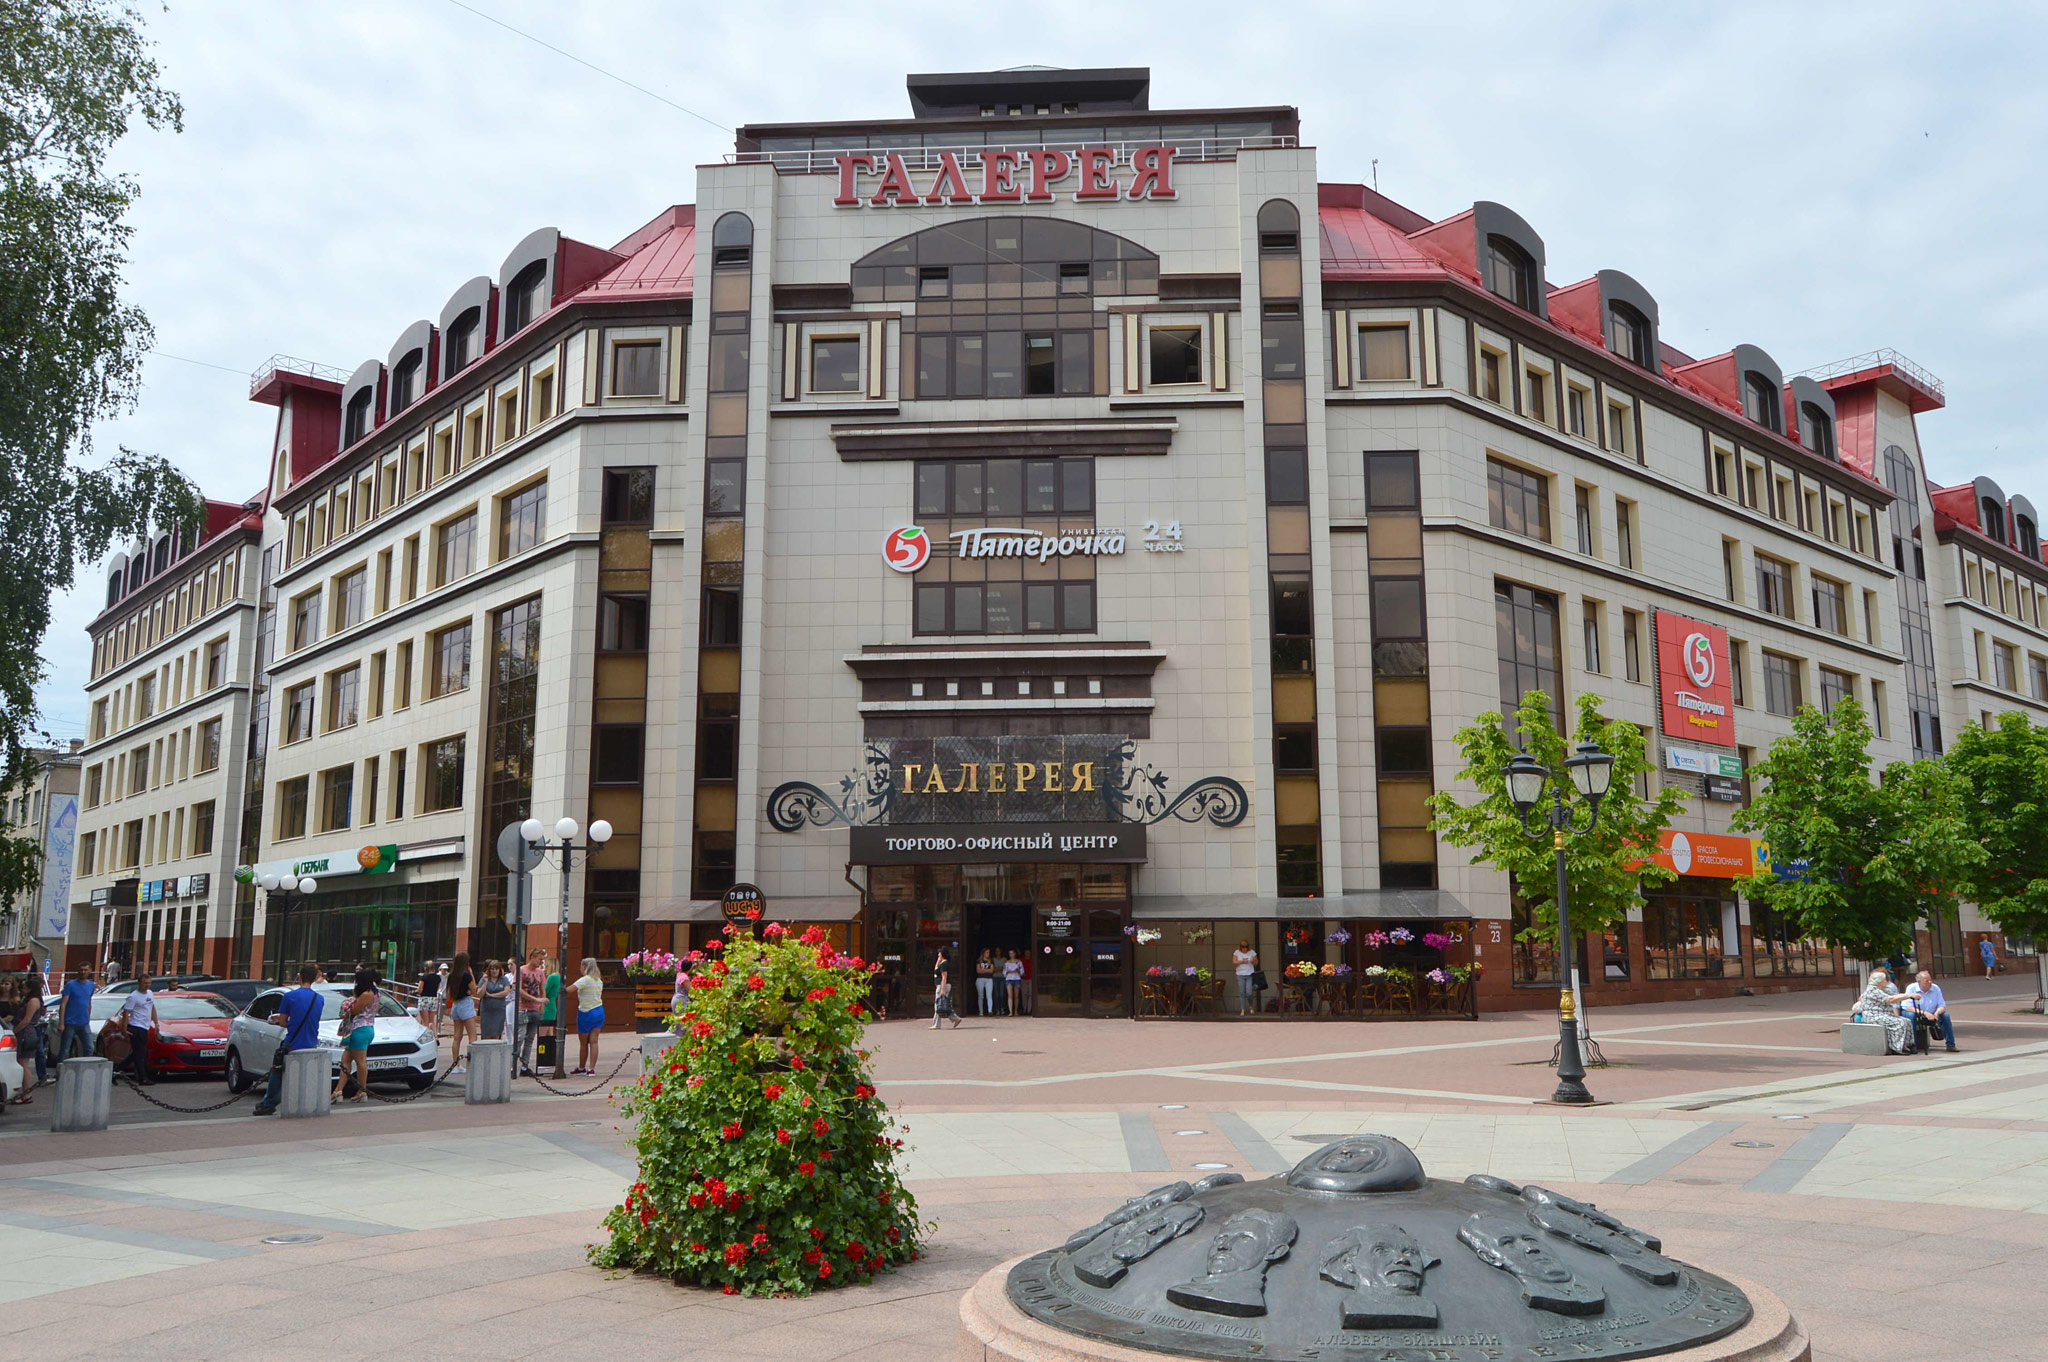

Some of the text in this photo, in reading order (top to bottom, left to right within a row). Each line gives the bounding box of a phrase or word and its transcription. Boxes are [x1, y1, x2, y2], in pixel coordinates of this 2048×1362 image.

[832, 146, 1180, 208] ГАЛЕРЕЯ
[1144, 520, 1184, 540] 24
[1144, 543, 1184, 552] ЧАСА
[902, 761, 1095, 794] ГАЛЕРЕЯ
[886, 832, 1118, 852] ТОРГОВО-ОФИСНЫЙ ЦЕНТР
[300, 858, 330, 875] СБЕРБАНК
[725, 899, 760, 915] LUCKY
[1490, 930, 1501, 943] 23
[1149, 1313, 1264, 1340] НИКОЛА ТЕСЛА
[1313, 1331, 1503, 1347] АЛЬБЕРТ ЭЙНШТЕЙН
